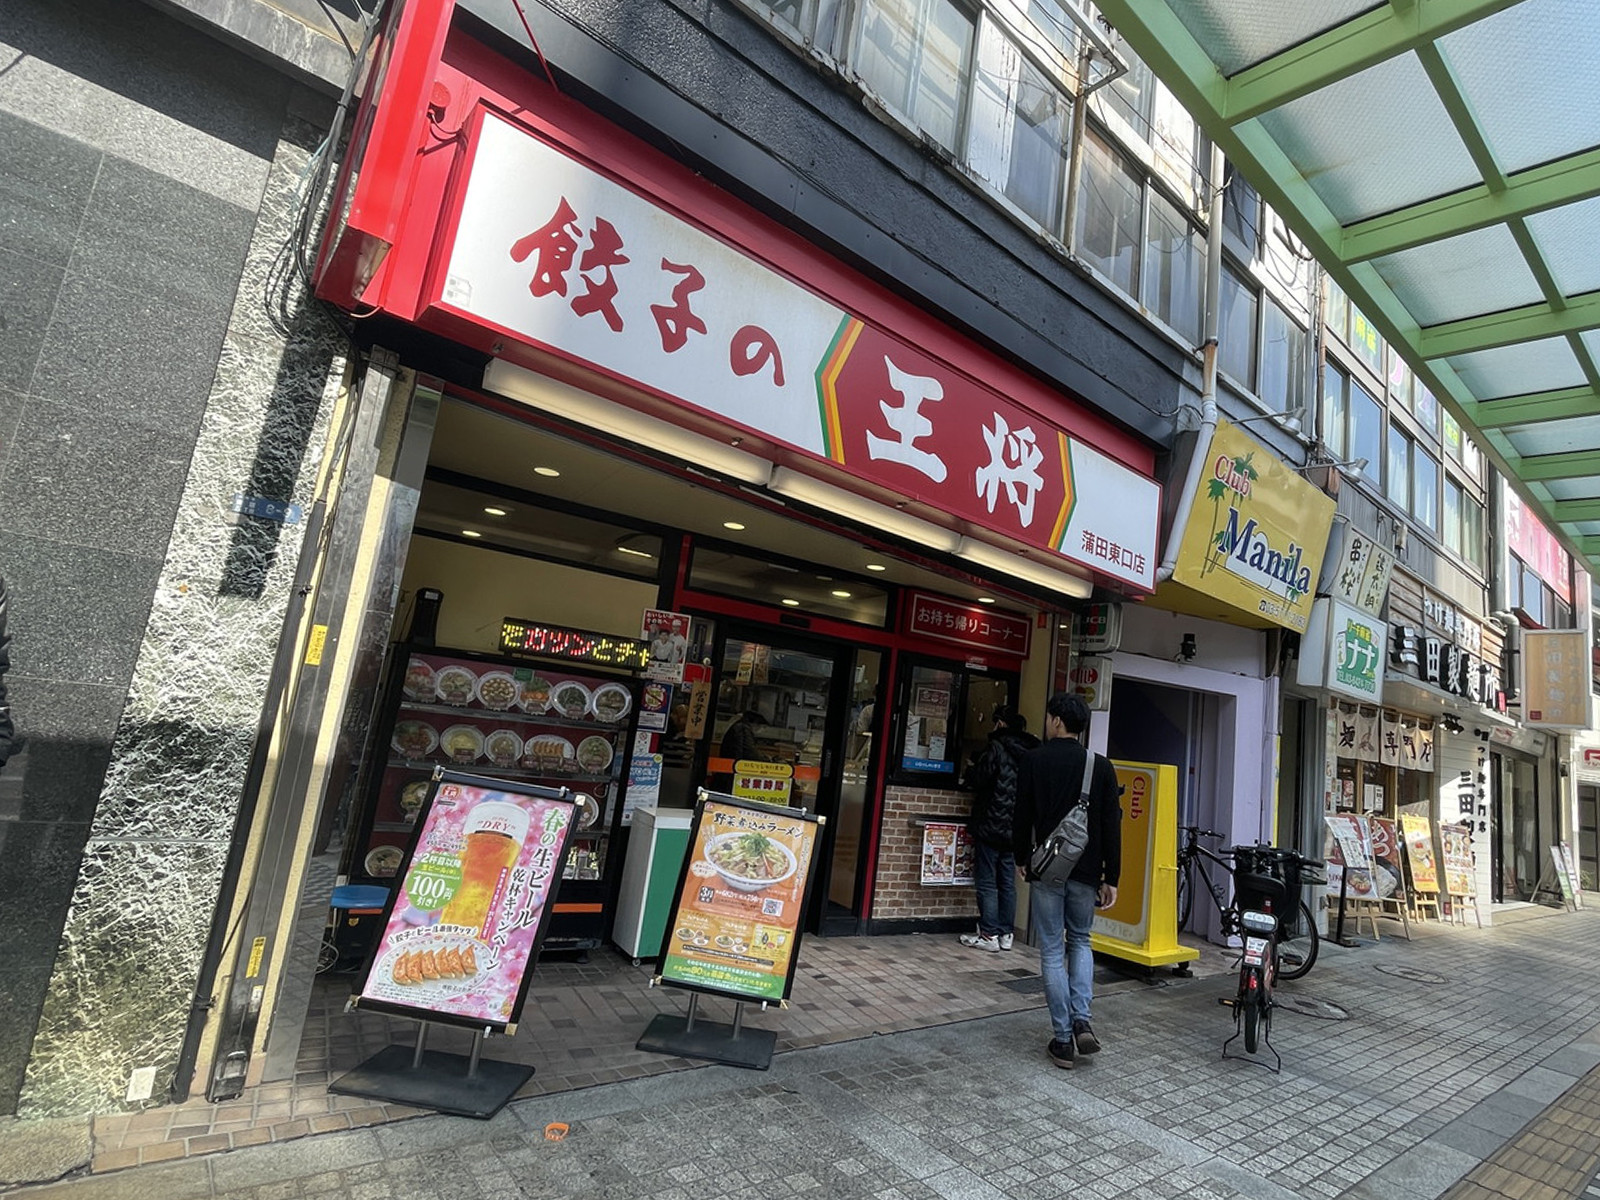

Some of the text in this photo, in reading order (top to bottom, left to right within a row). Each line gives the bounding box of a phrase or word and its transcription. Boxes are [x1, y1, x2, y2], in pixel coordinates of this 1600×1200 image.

[510, 195, 1044, 528] 餃子の王将
[1215, 454, 1251, 496] Club
[1081, 529, 1146, 576] 蒲田東口店
[1218, 507, 1312, 594] Manila
[917, 606, 1025, 642] お持ち帰りコーナー
[1347, 639, 1375, 675] ナナ
[691, 689, 709, 728] 営業中
[1131, 776, 1146, 819] Club
[713, 812, 804, 838] 野菜煮込みラーメン
[513, 808, 566, 928] 春の生ビール
[486, 868, 526, 970] 乾杯キャンペーン
